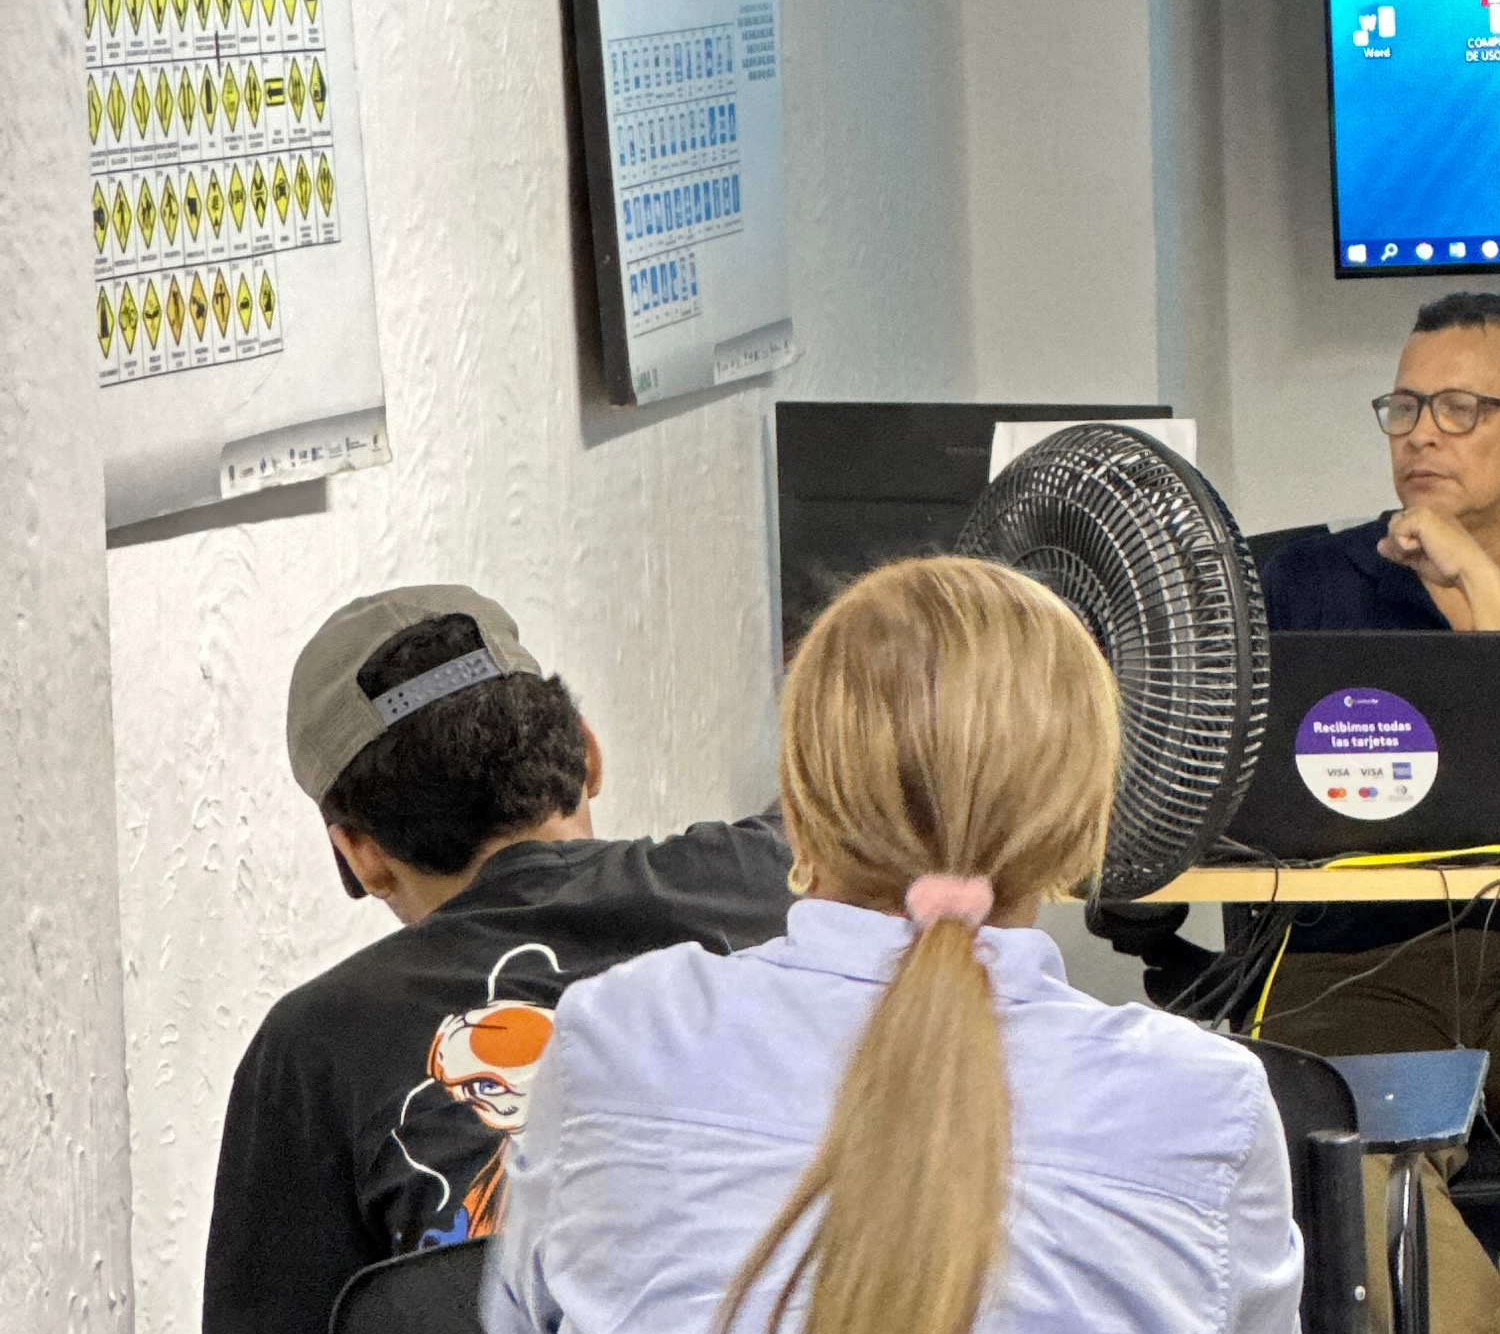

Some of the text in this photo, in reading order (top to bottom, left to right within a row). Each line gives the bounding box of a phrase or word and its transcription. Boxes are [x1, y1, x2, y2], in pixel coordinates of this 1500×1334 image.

[1363, 47, 1391, 58] Word
[1465, 51, 1478, 62] DE
[1313, 721, 1411, 733] Recibimos todas
[1331, 736, 1399, 749] las tarjetas
[1327, 768, 1350, 777] VISA
[1360, 768, 1384, 777] VISA
